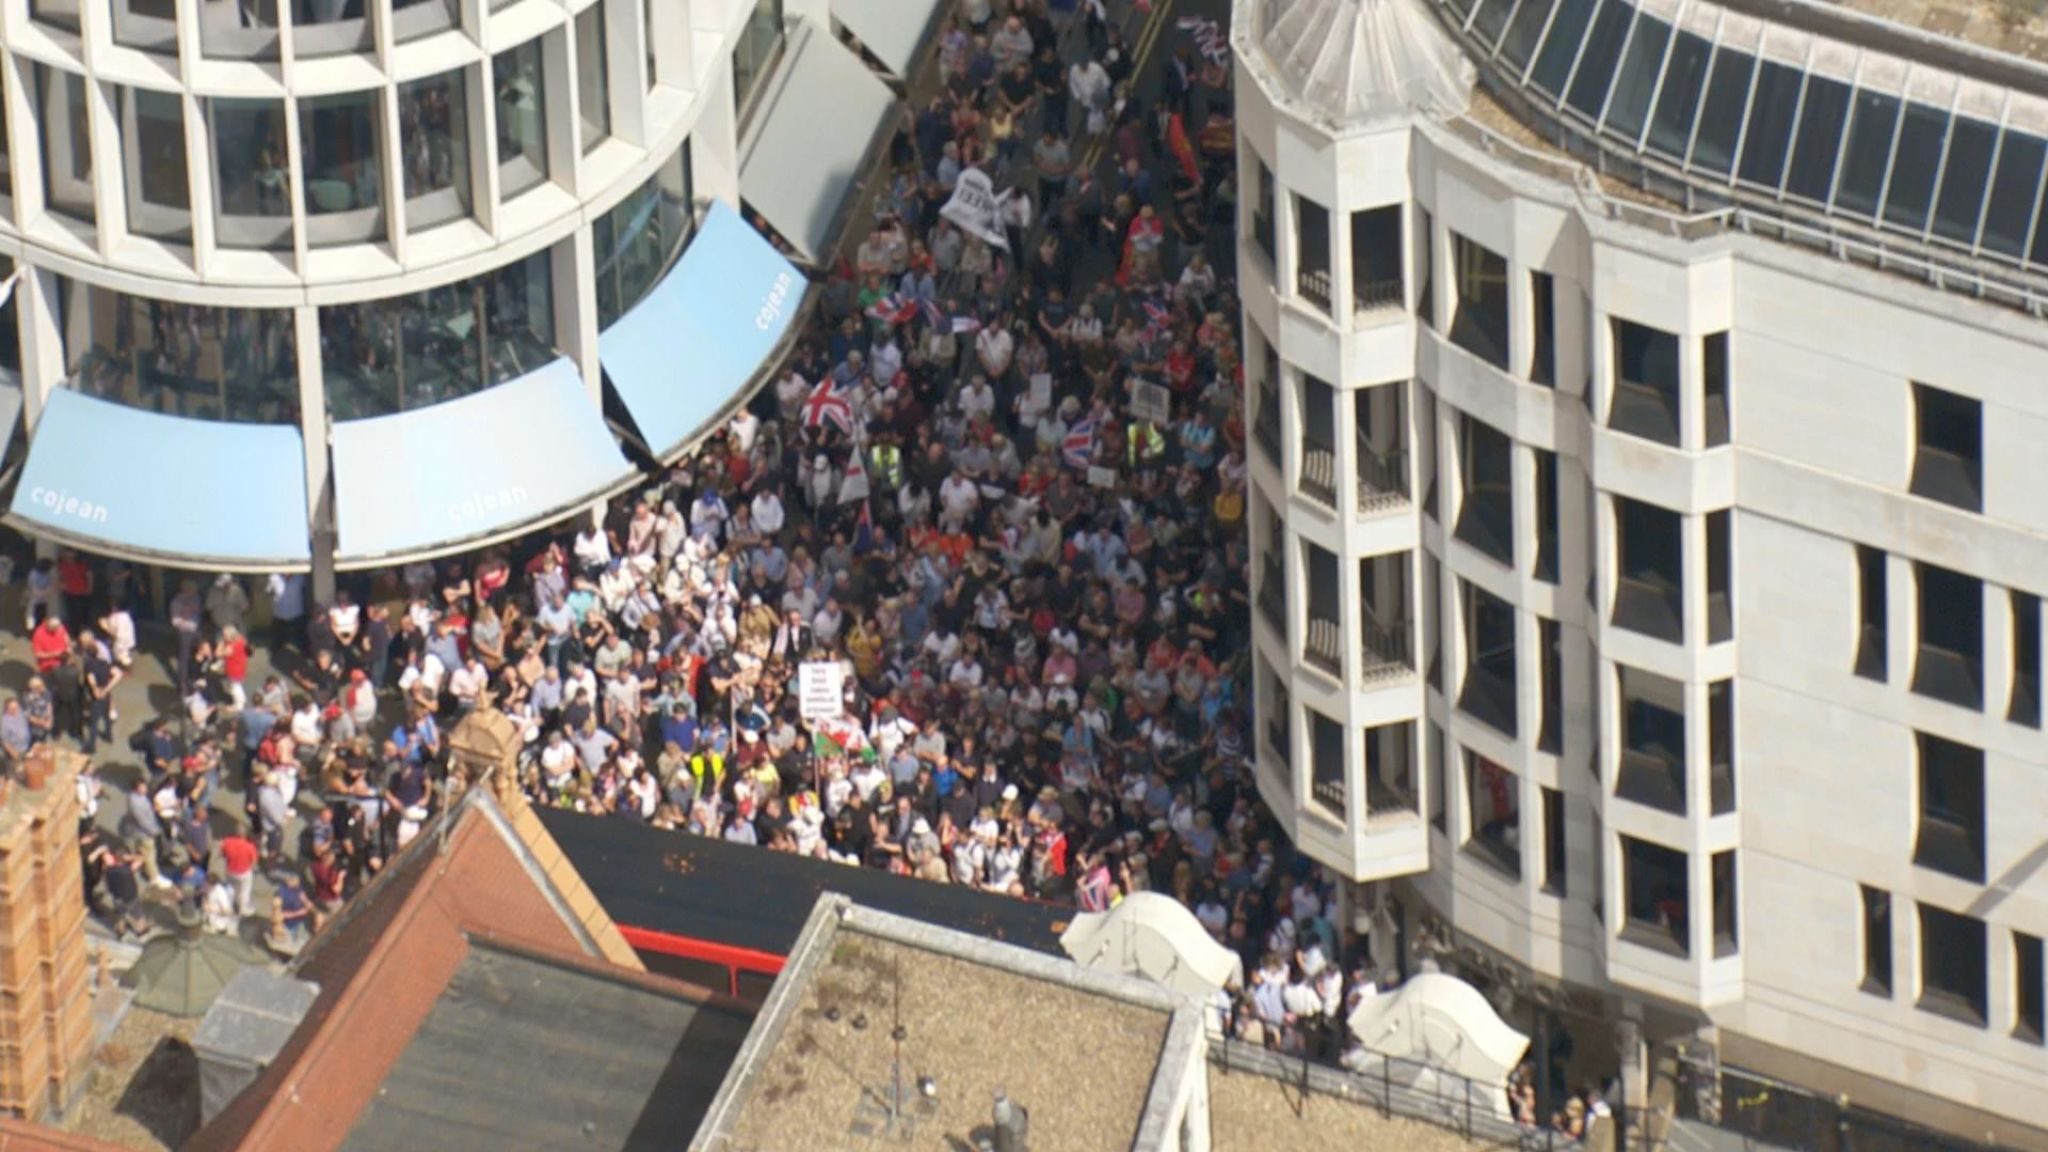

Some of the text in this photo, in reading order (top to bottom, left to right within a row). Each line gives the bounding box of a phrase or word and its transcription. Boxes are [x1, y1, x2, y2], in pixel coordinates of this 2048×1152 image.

[754, 271, 792, 330] cojean
[31, 486, 108, 523] cojean
[447, 487, 528, 521] cojean
